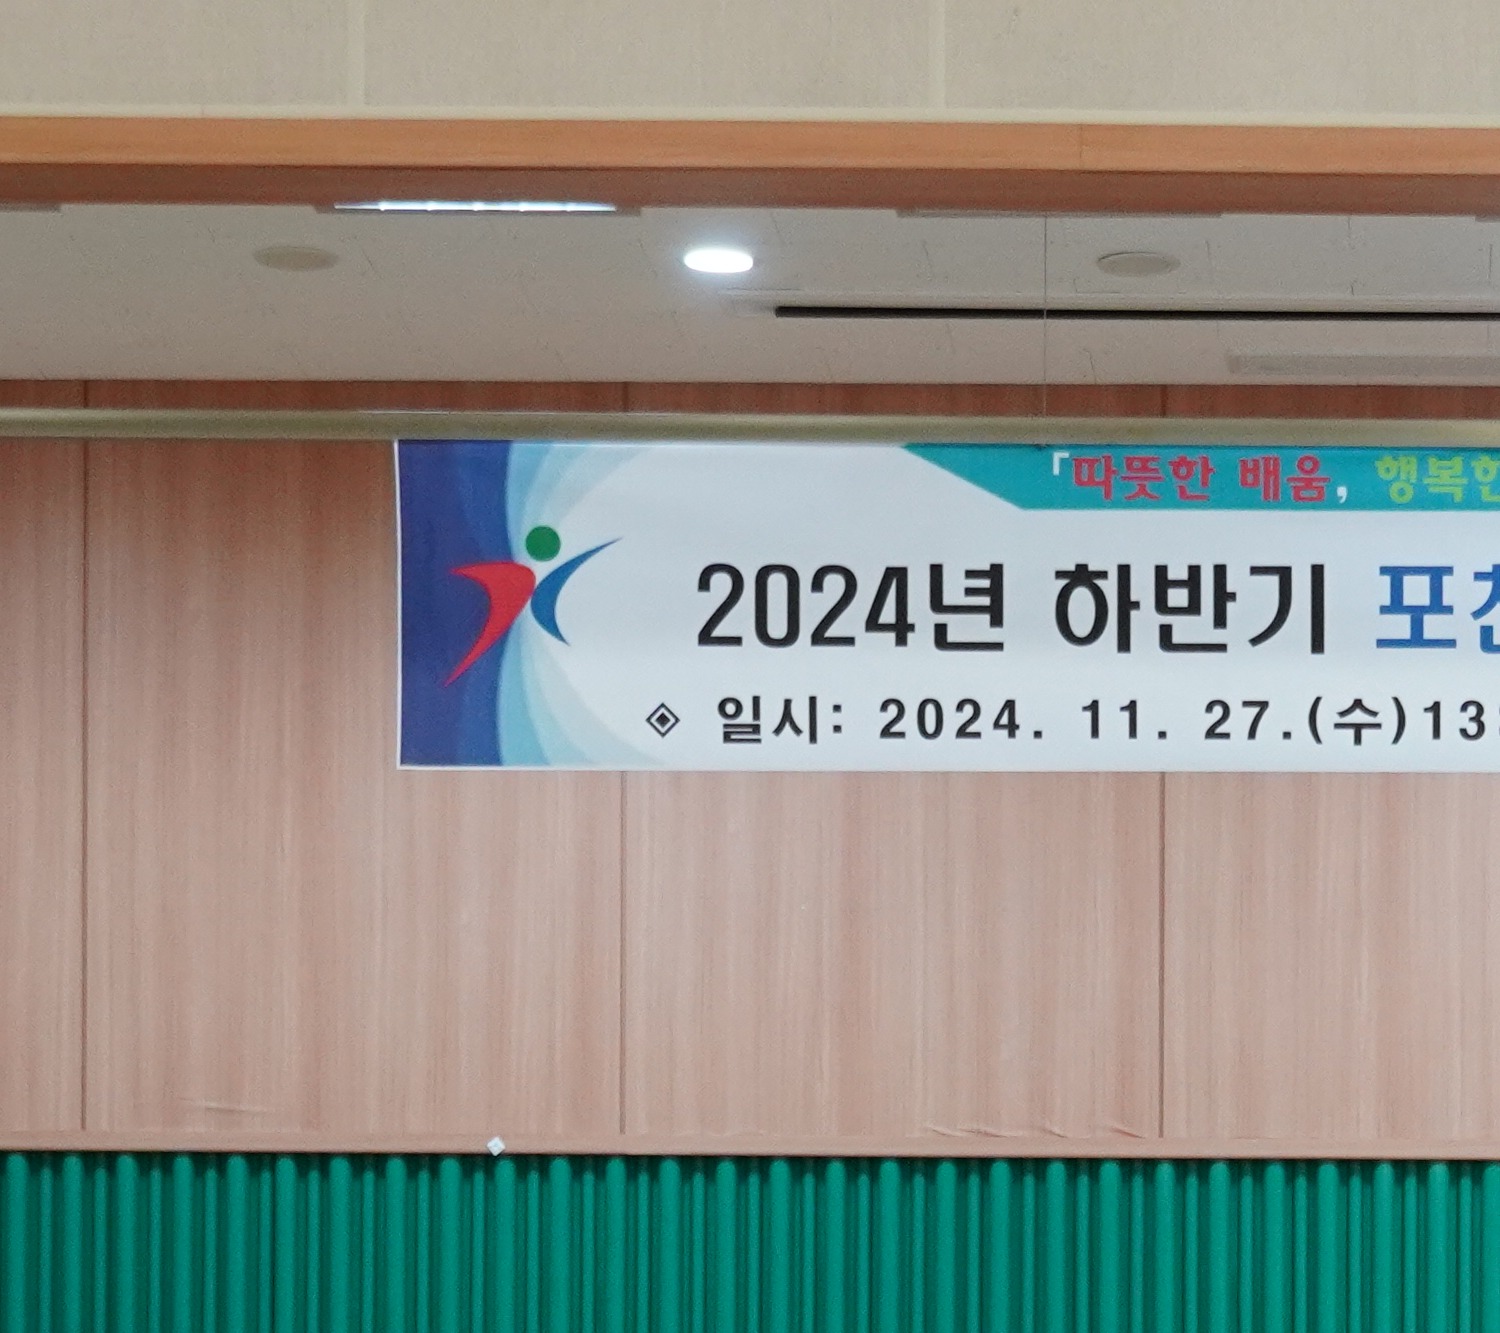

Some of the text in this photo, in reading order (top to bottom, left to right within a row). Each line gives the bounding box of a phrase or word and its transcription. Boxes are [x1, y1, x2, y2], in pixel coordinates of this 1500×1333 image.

[1236, 453, 1350, 506] 배움,
[696, 562, 1009, 654] 2024년
[1055, 562, 1329, 655] 하반기
[715, 696, 845, 745] 일시:
[879, 698, 1045, 742] 2024.
[1082, 698, 1166, 742] 11.
